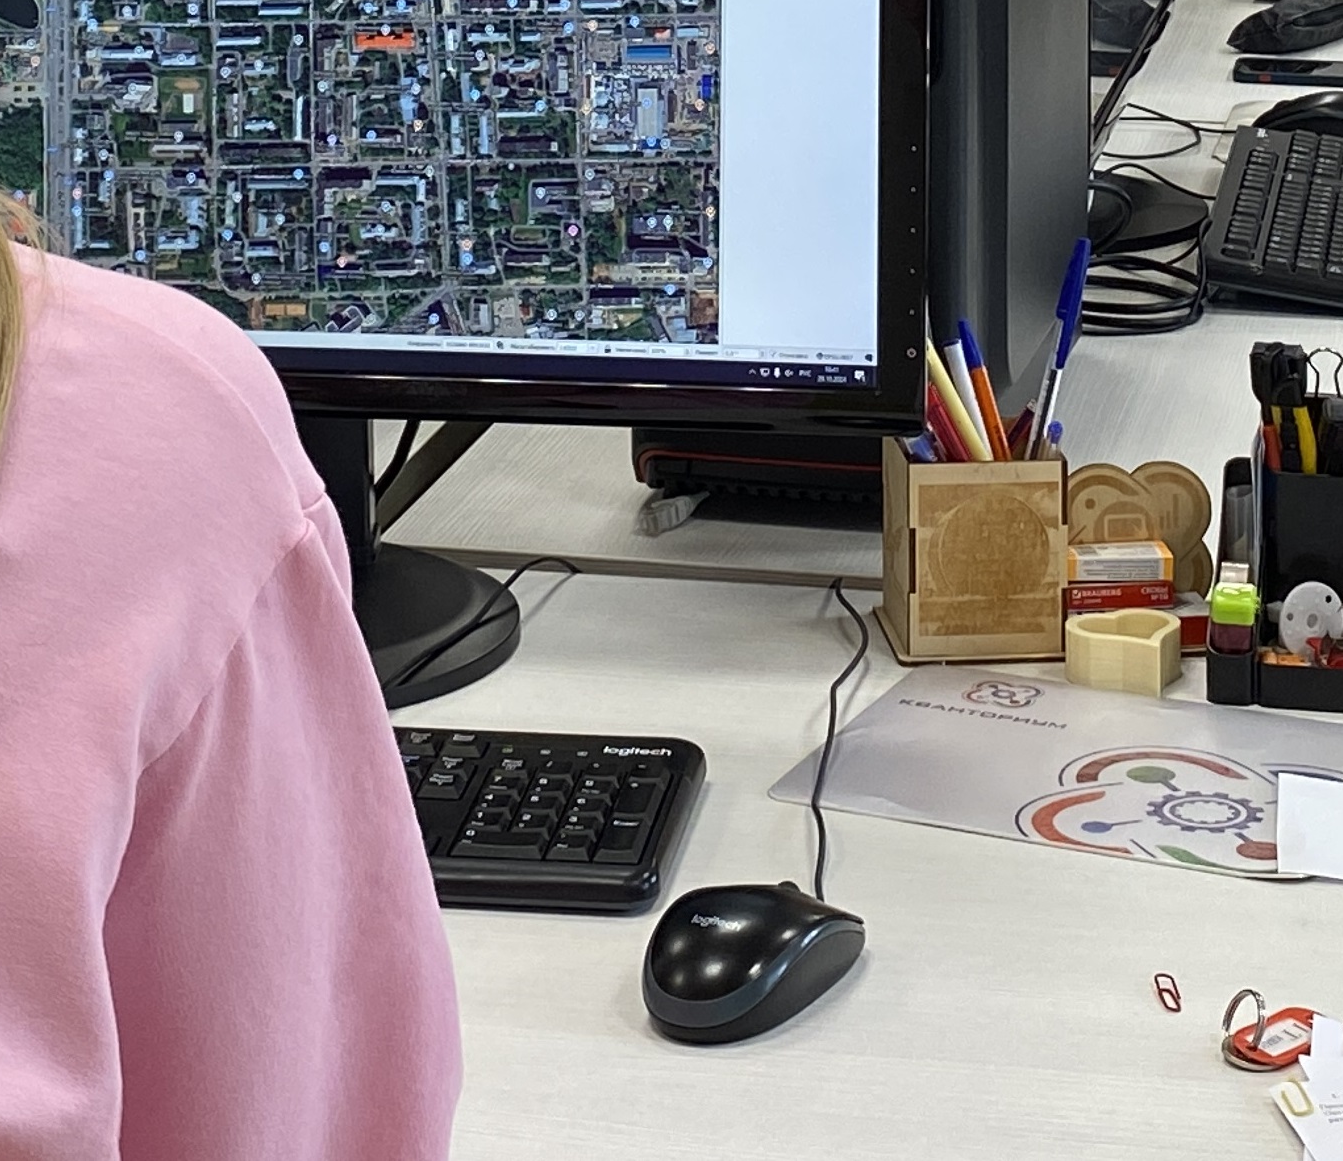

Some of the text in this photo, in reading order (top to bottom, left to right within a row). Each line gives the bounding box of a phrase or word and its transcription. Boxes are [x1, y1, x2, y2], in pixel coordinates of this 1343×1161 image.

[898, 698, 1067, 730] КВАНТОРИУМ
[602, 745, 672, 757] logitech
[691, 913, 742, 932] logitech
